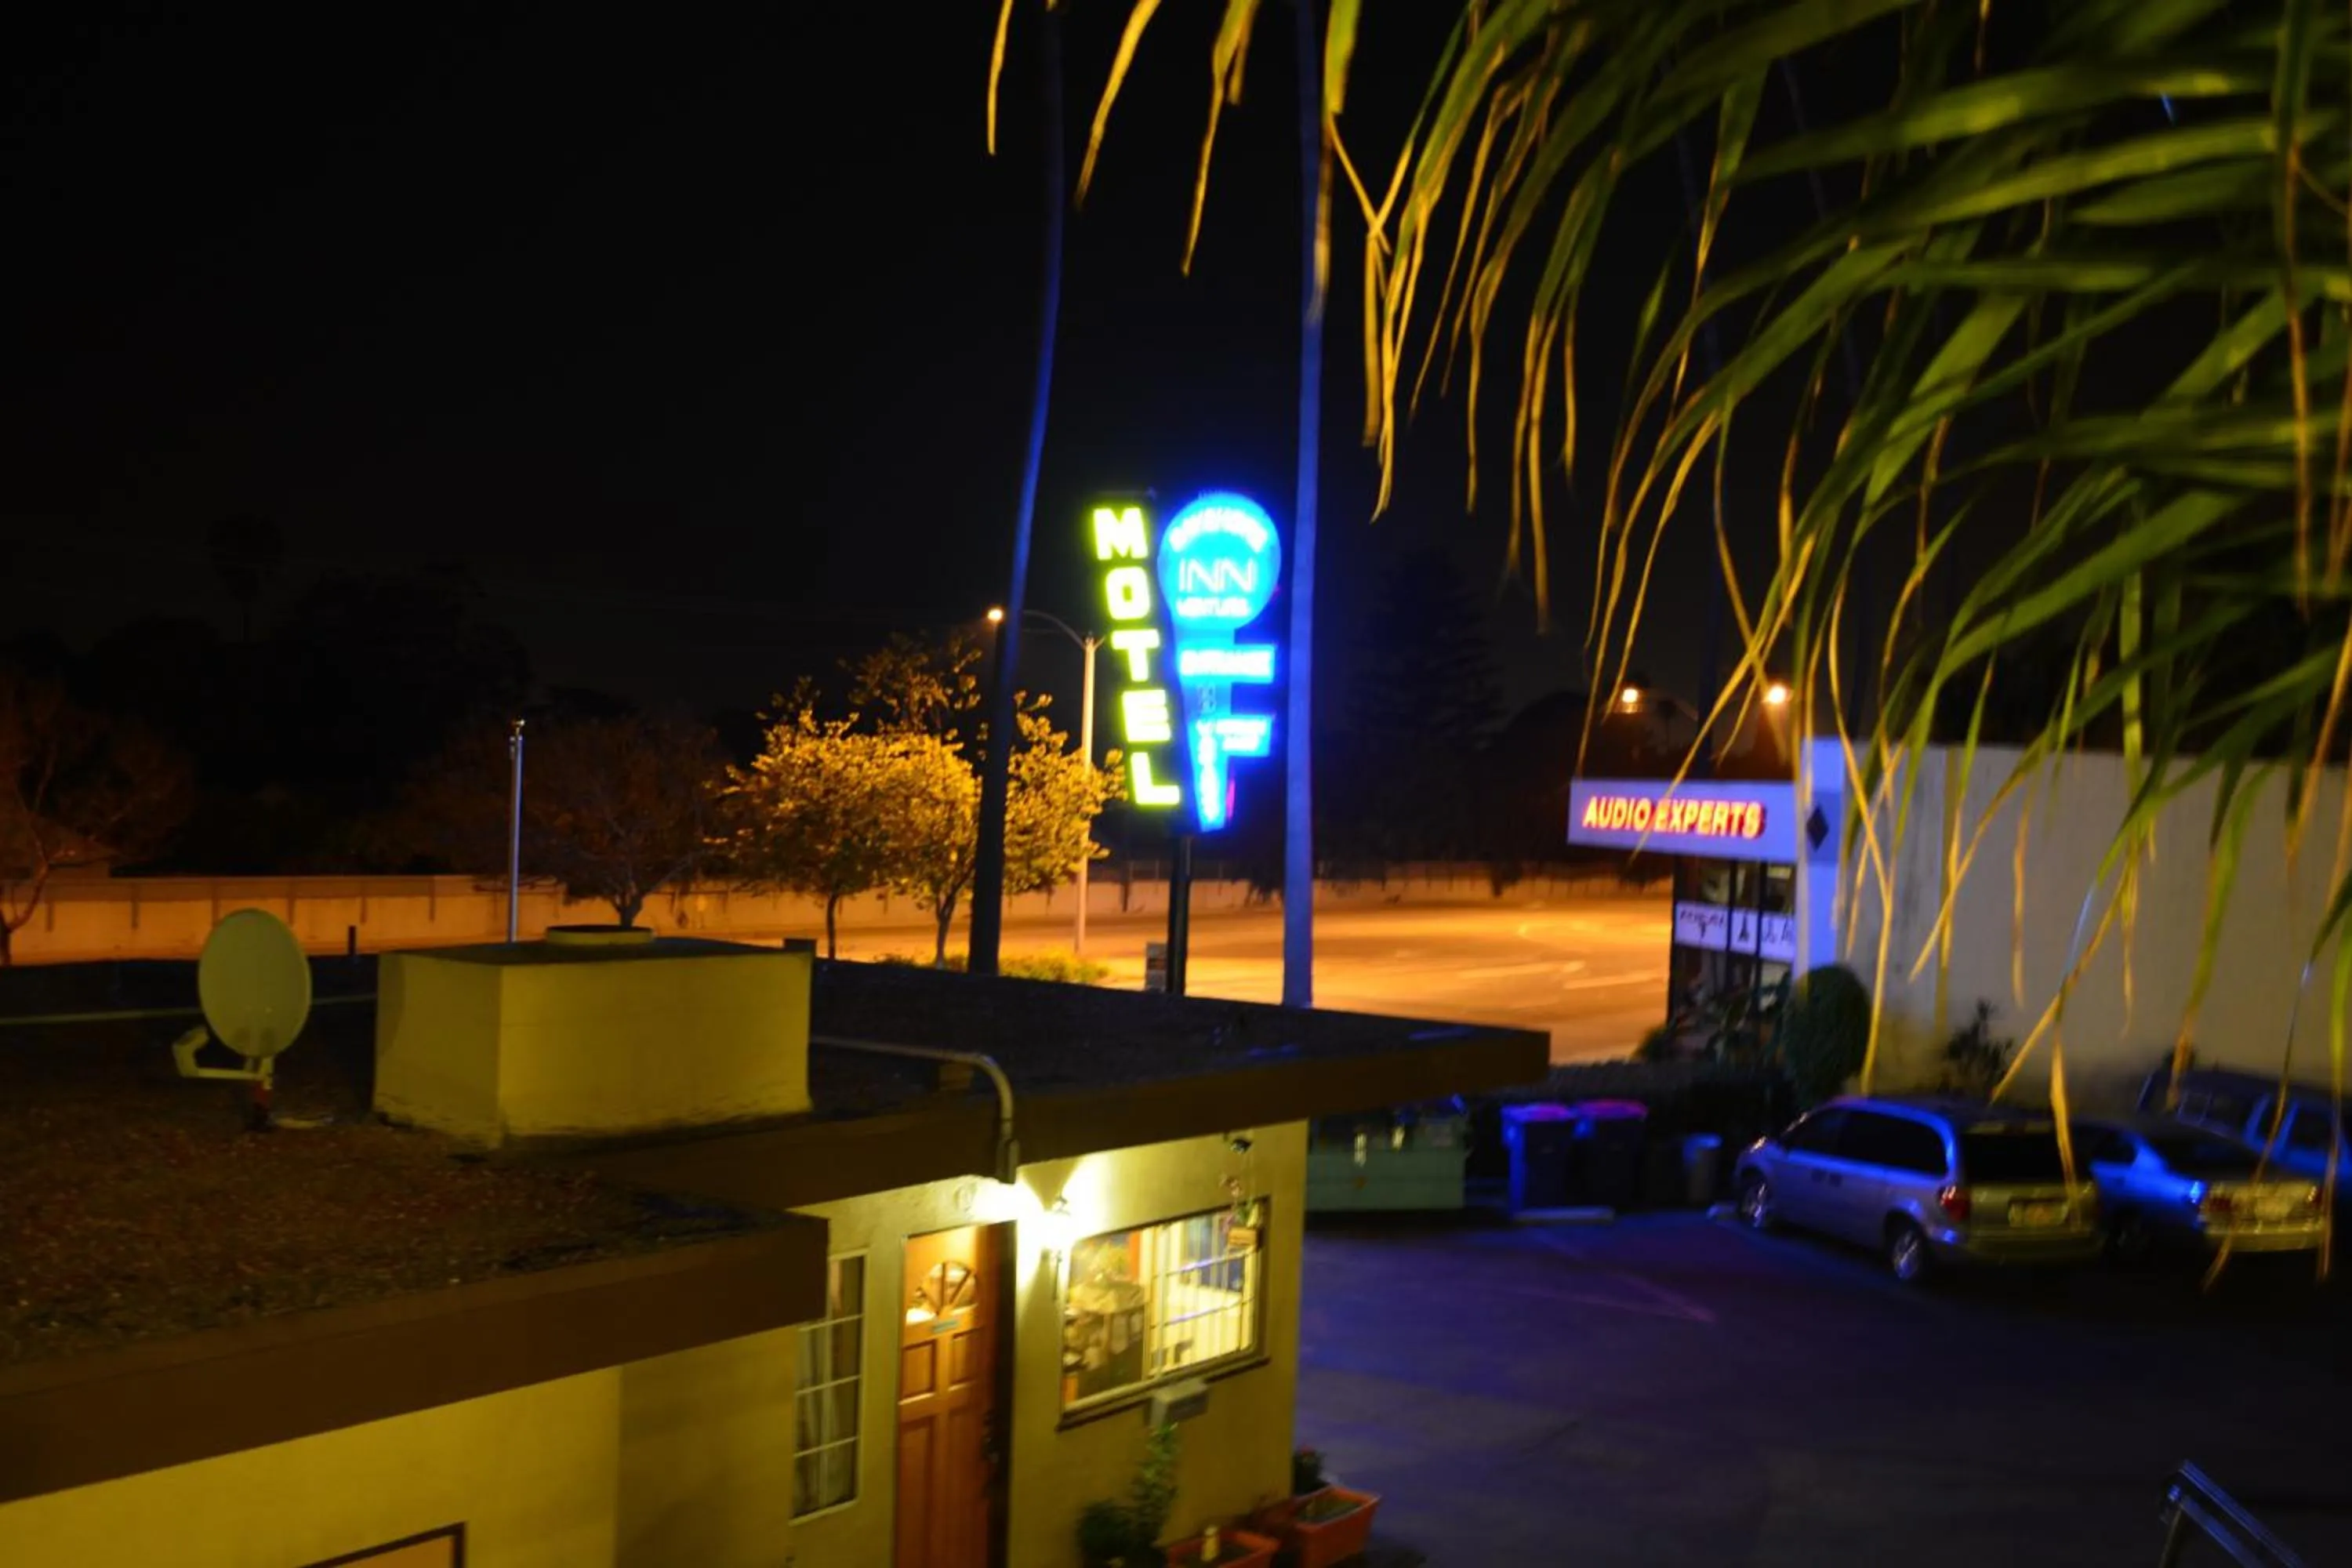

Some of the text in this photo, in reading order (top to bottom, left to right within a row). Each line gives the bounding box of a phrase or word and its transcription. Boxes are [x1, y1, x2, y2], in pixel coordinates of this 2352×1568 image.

[1178, 557, 1256, 593] INN
[1093, 506, 1180, 805] MOTEL
[1582, 796, 1765, 839] AUDIO EXPERTS
